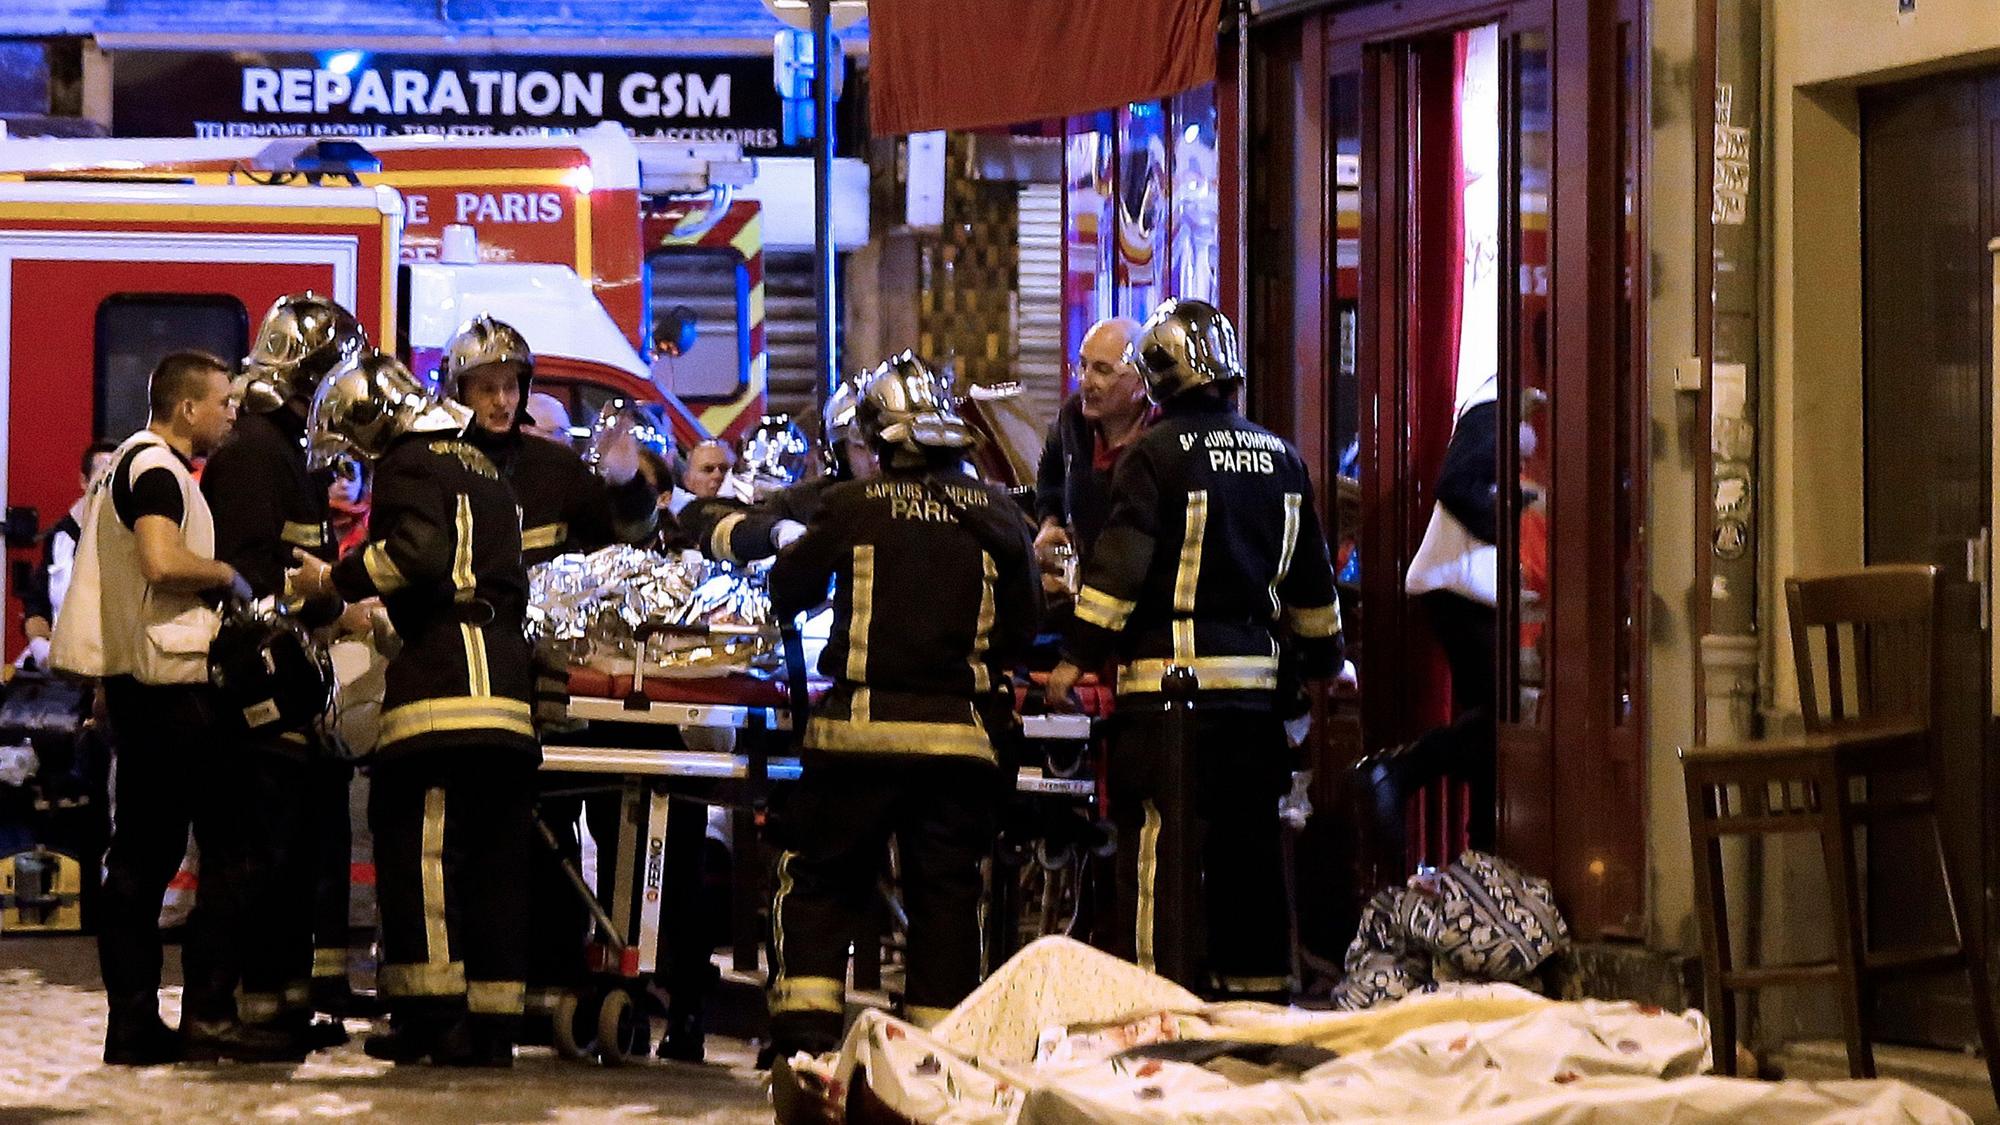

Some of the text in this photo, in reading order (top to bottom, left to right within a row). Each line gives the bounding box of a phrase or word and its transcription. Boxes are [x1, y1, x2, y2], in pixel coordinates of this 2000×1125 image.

[242, 67, 731, 118] REPARATION GSM
[456, 192, 563, 223] PARIS
[1208, 448, 1274, 474] PARIS
